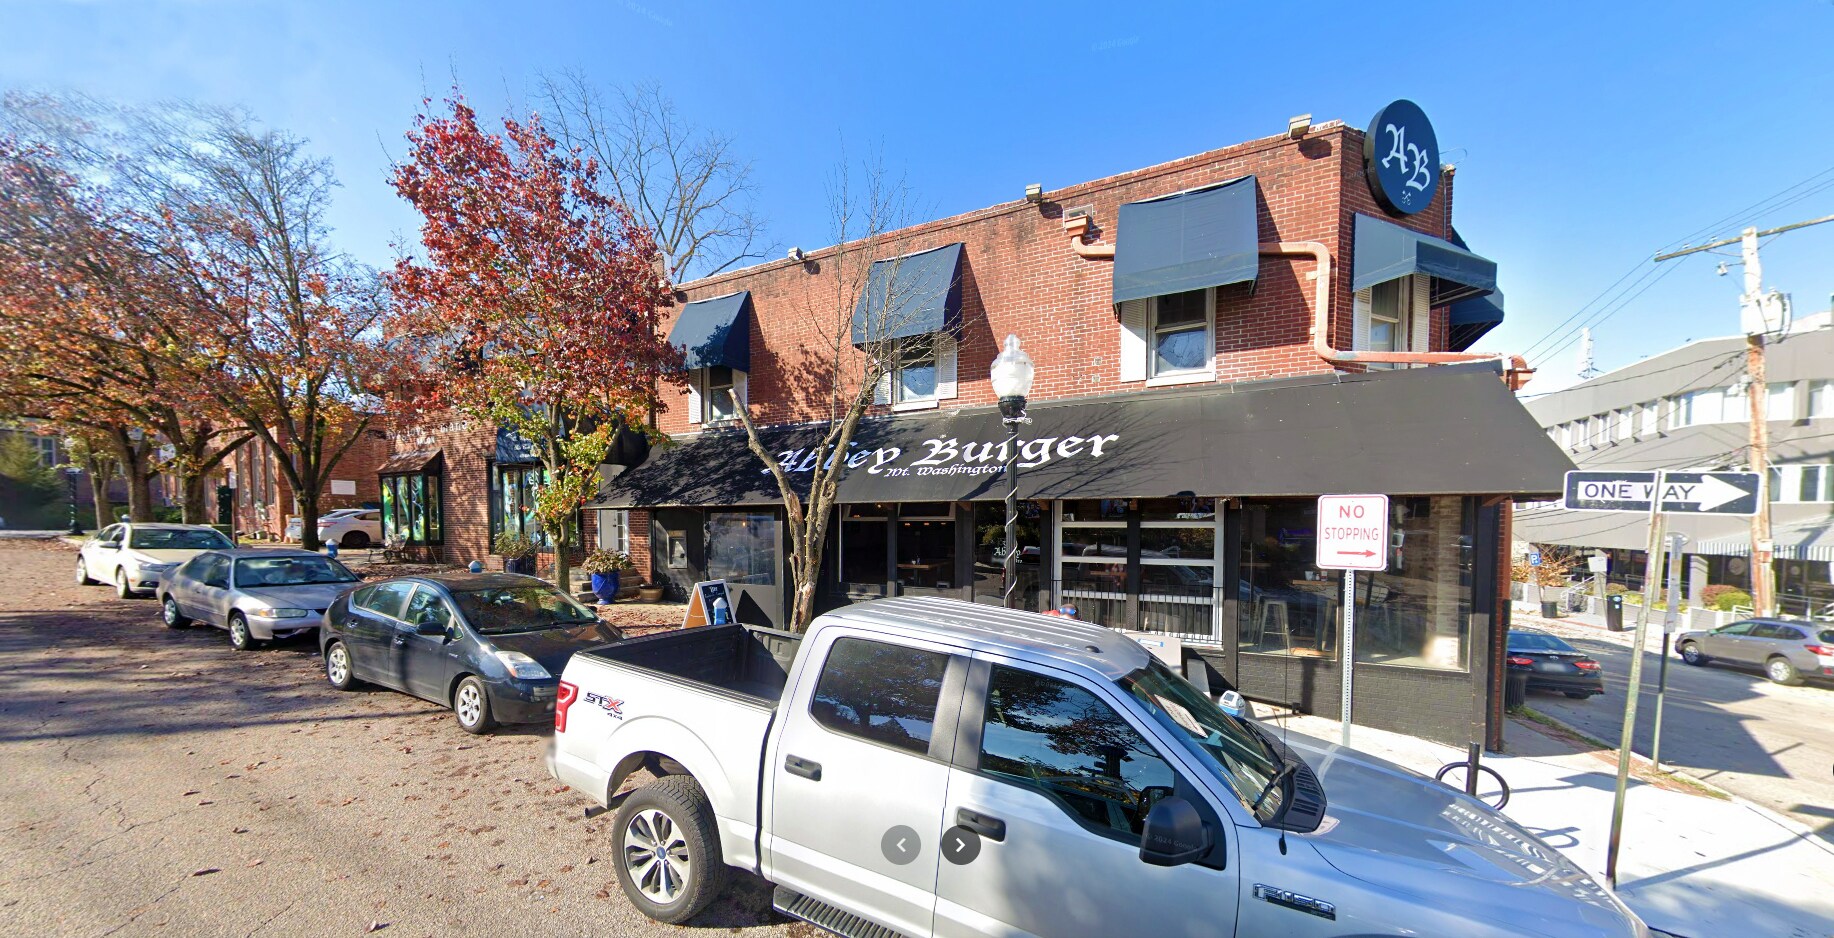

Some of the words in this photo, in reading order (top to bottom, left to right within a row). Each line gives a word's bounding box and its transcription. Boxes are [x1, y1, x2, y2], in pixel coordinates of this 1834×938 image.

[909, 433, 1120, 469] Burger
[884, 467, 911, 478] Mt.
[917, 463, 1008, 477] Washington
[1584, 483, 1633, 499] ONE
[1339, 505, 1365, 519] NO
[1324, 527, 1379, 541] STOPPING
[583, 691, 625, 715] STX
